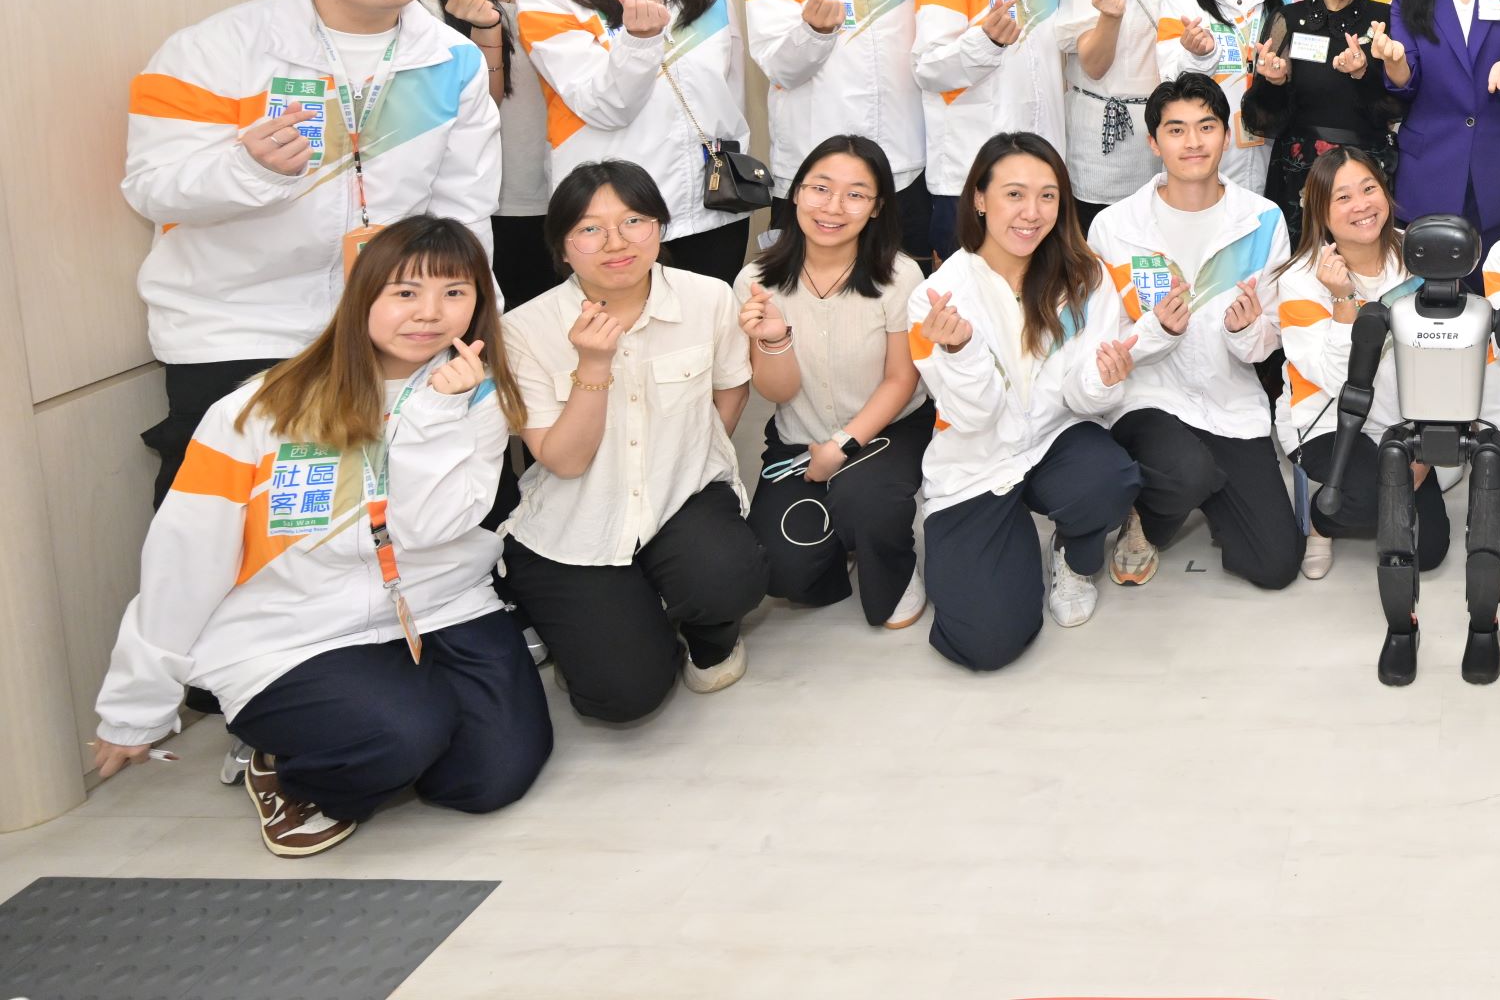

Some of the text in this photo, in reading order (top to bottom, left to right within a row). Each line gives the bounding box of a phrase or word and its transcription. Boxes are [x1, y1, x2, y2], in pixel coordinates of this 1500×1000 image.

[1133, 272, 1171, 289] 社區
[1416, 332, 1459, 340] BOOSTER
[272, 462, 338, 489] 社區
[270, 489, 333, 516] 客廳
[296, 519, 316, 527] Wan
